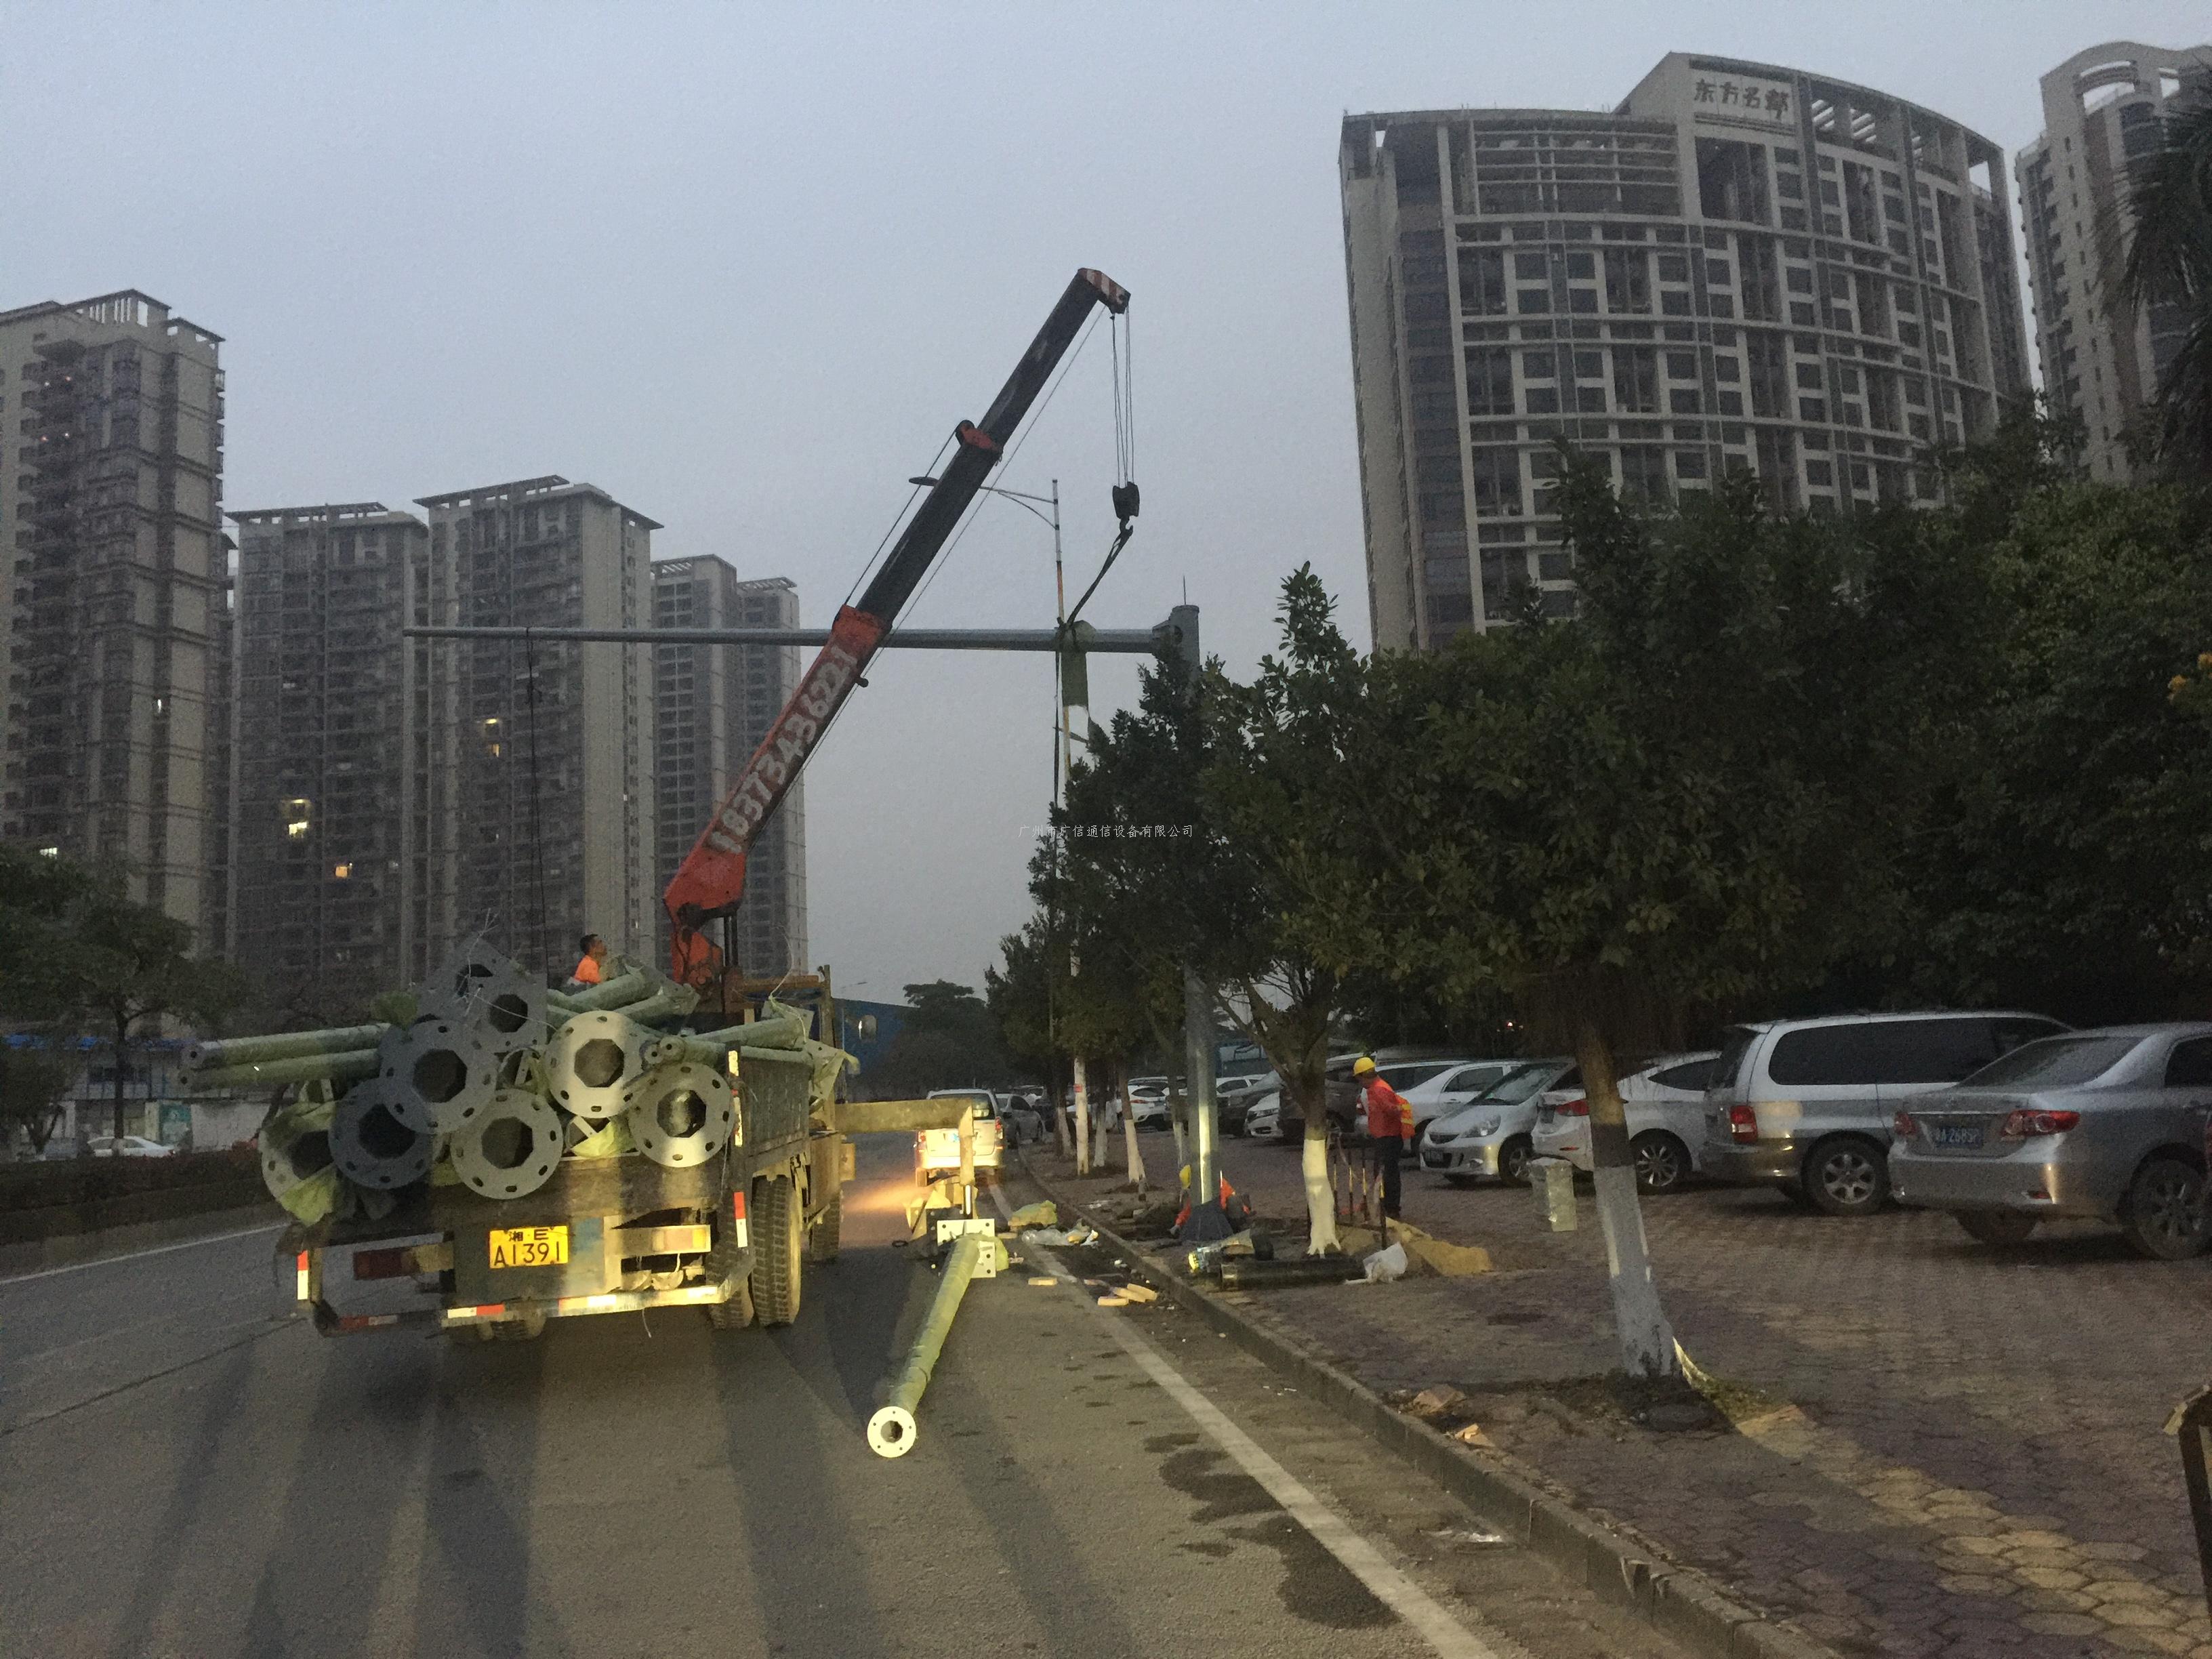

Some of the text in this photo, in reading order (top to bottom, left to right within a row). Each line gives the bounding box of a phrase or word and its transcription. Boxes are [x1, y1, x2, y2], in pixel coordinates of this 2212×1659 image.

[1694, 78, 1790, 121] 东方名都
[493, 1241, 560, 1266] A1391
